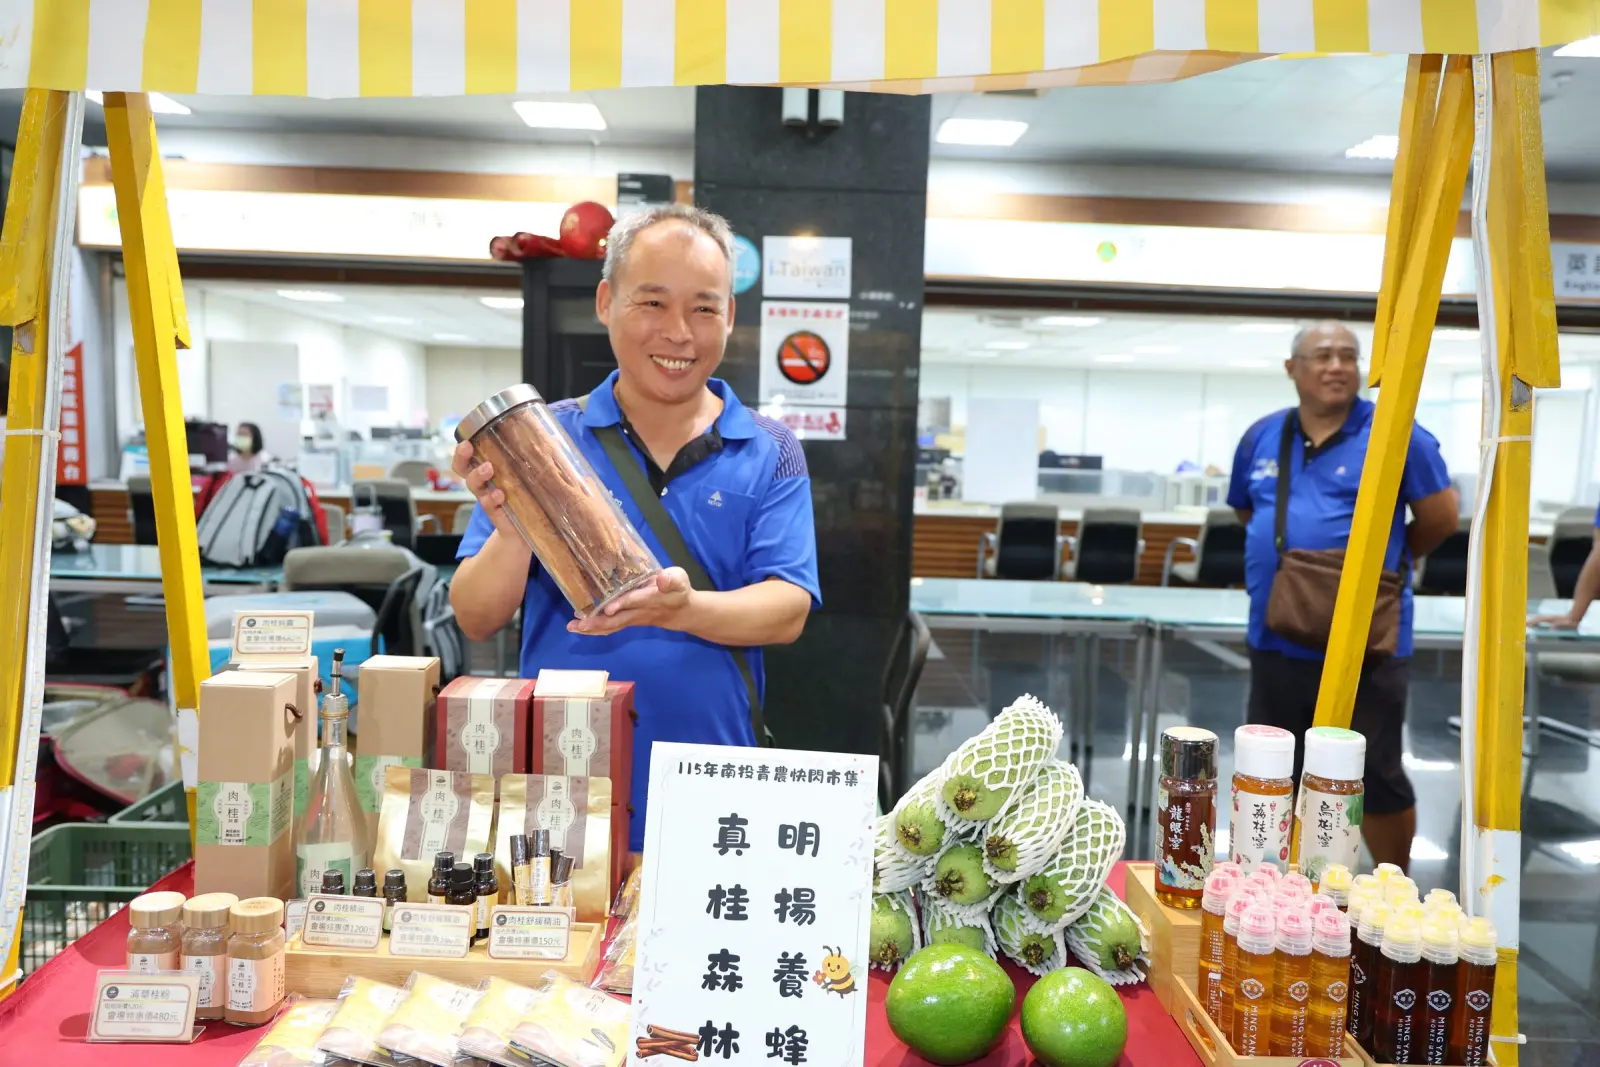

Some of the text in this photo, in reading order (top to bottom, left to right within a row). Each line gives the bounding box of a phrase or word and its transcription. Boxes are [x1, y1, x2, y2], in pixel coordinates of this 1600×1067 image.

[678, 761, 859, 787] 115年南投青農快閃市集
[1353, 989, 1361, 1018] MING
[1249, 1005, 1258, 1031] MING
[1336, 1007, 1344, 1034] MING
[1403, 1015, 1412, 1042] MING
[1436, 1016, 1446, 1043] MING
[1473, 1016, 1484, 1066] MING YAN
